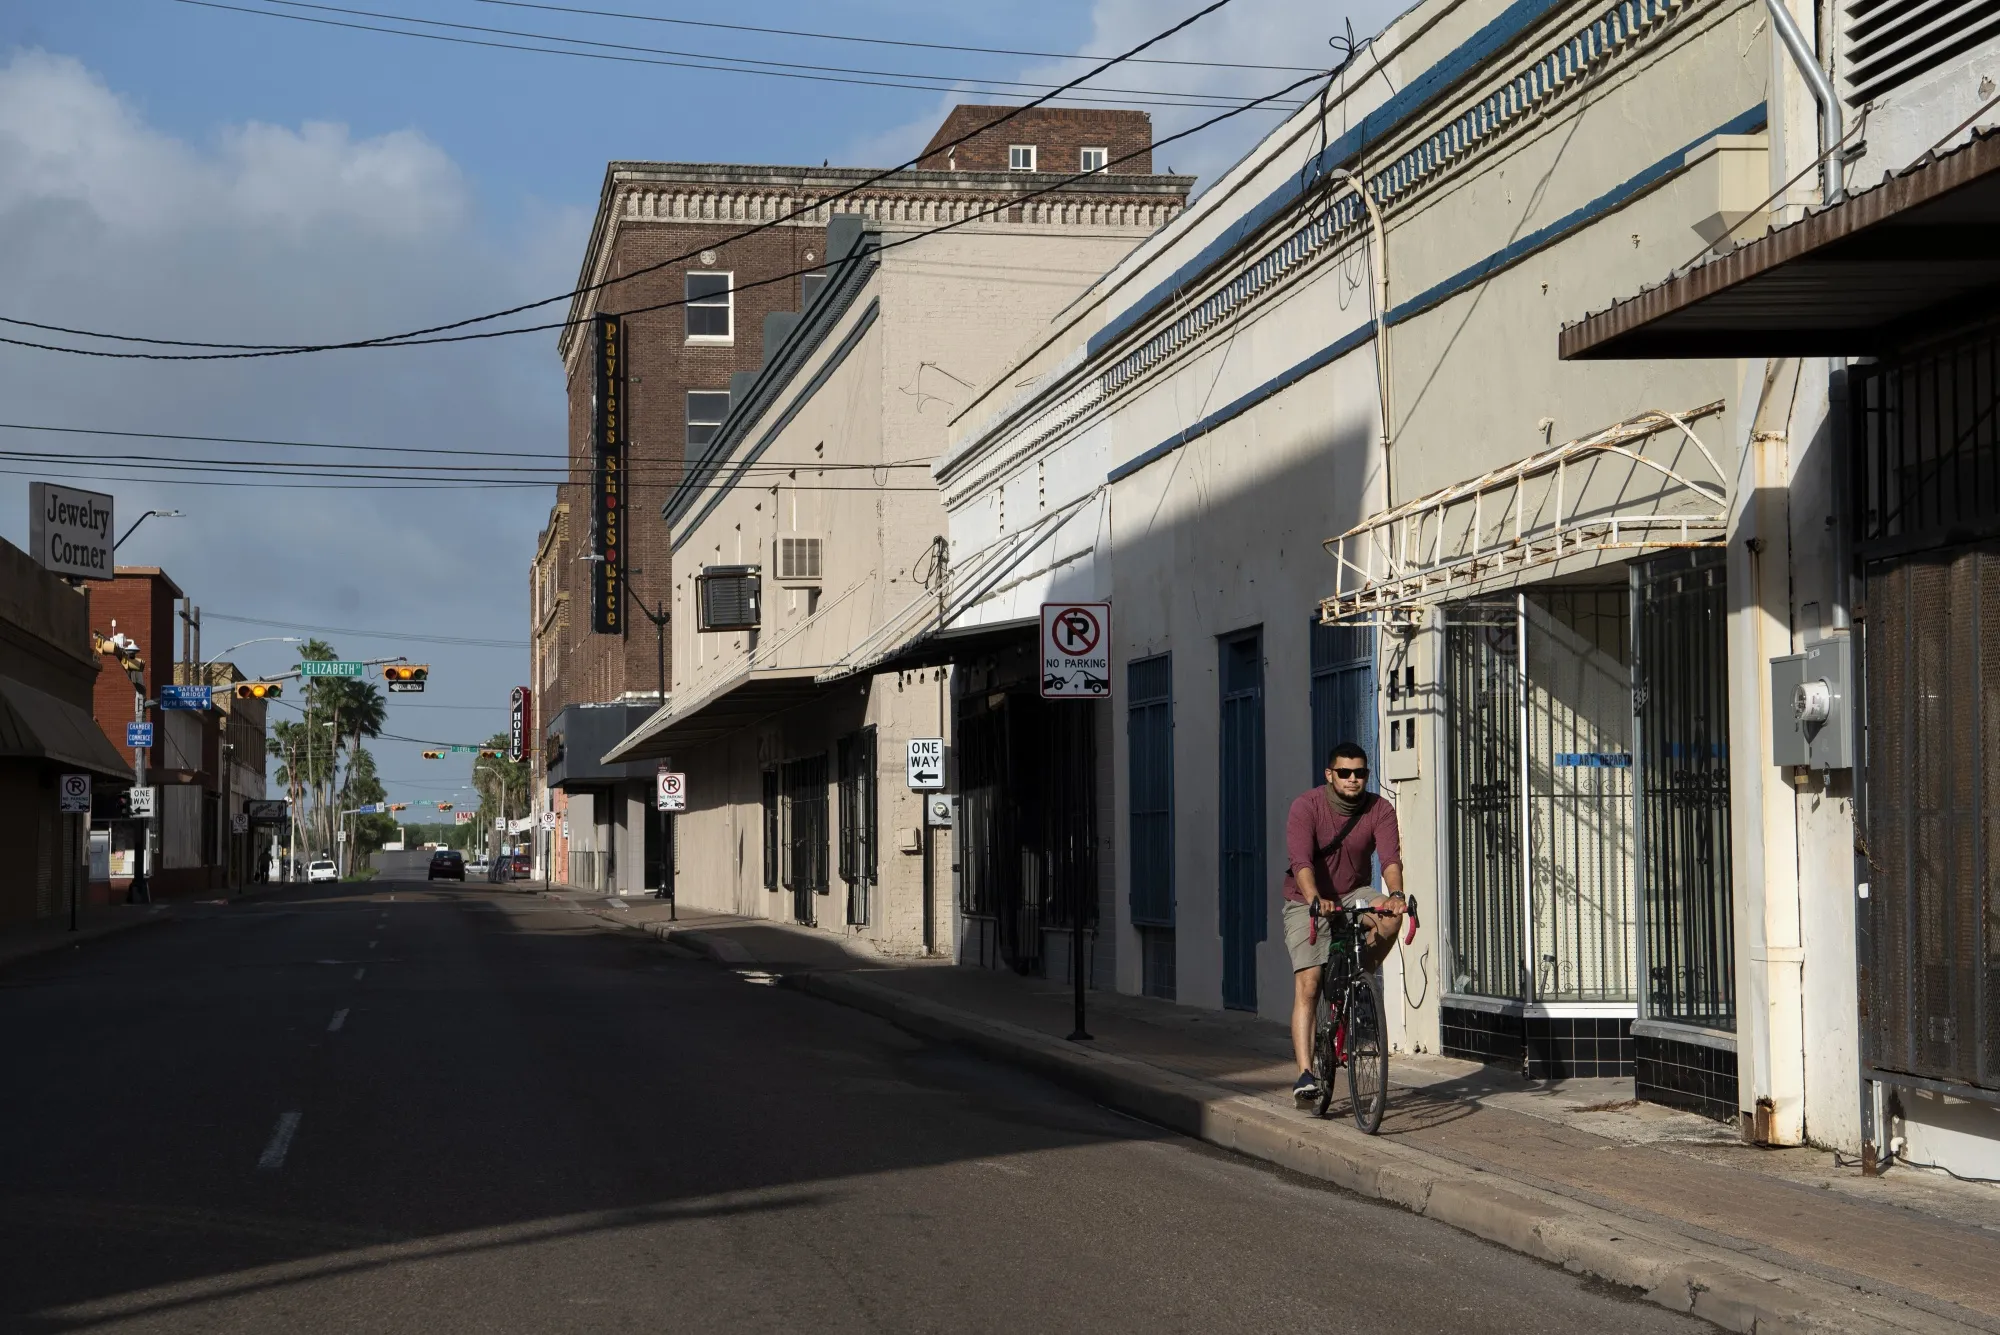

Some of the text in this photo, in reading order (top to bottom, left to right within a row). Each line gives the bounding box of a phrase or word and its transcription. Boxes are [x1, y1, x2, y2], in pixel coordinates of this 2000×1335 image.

[605, 322, 616, 444] Payless
[48, 494, 110, 540] Jewelry
[51, 533, 107, 570] Corner
[306, 663, 355, 675] ELIZABETH
[1046, 659, 1106, 668] NO PARKING
[513, 712, 521, 755] HOTEL
[912, 742, 939, 754] ONE
[910, 756, 940, 768] WAY
[1580, 754, 1594, 766] ART
[134, 789, 150, 797] ONE
[133, 797, 151, 805] WAY
